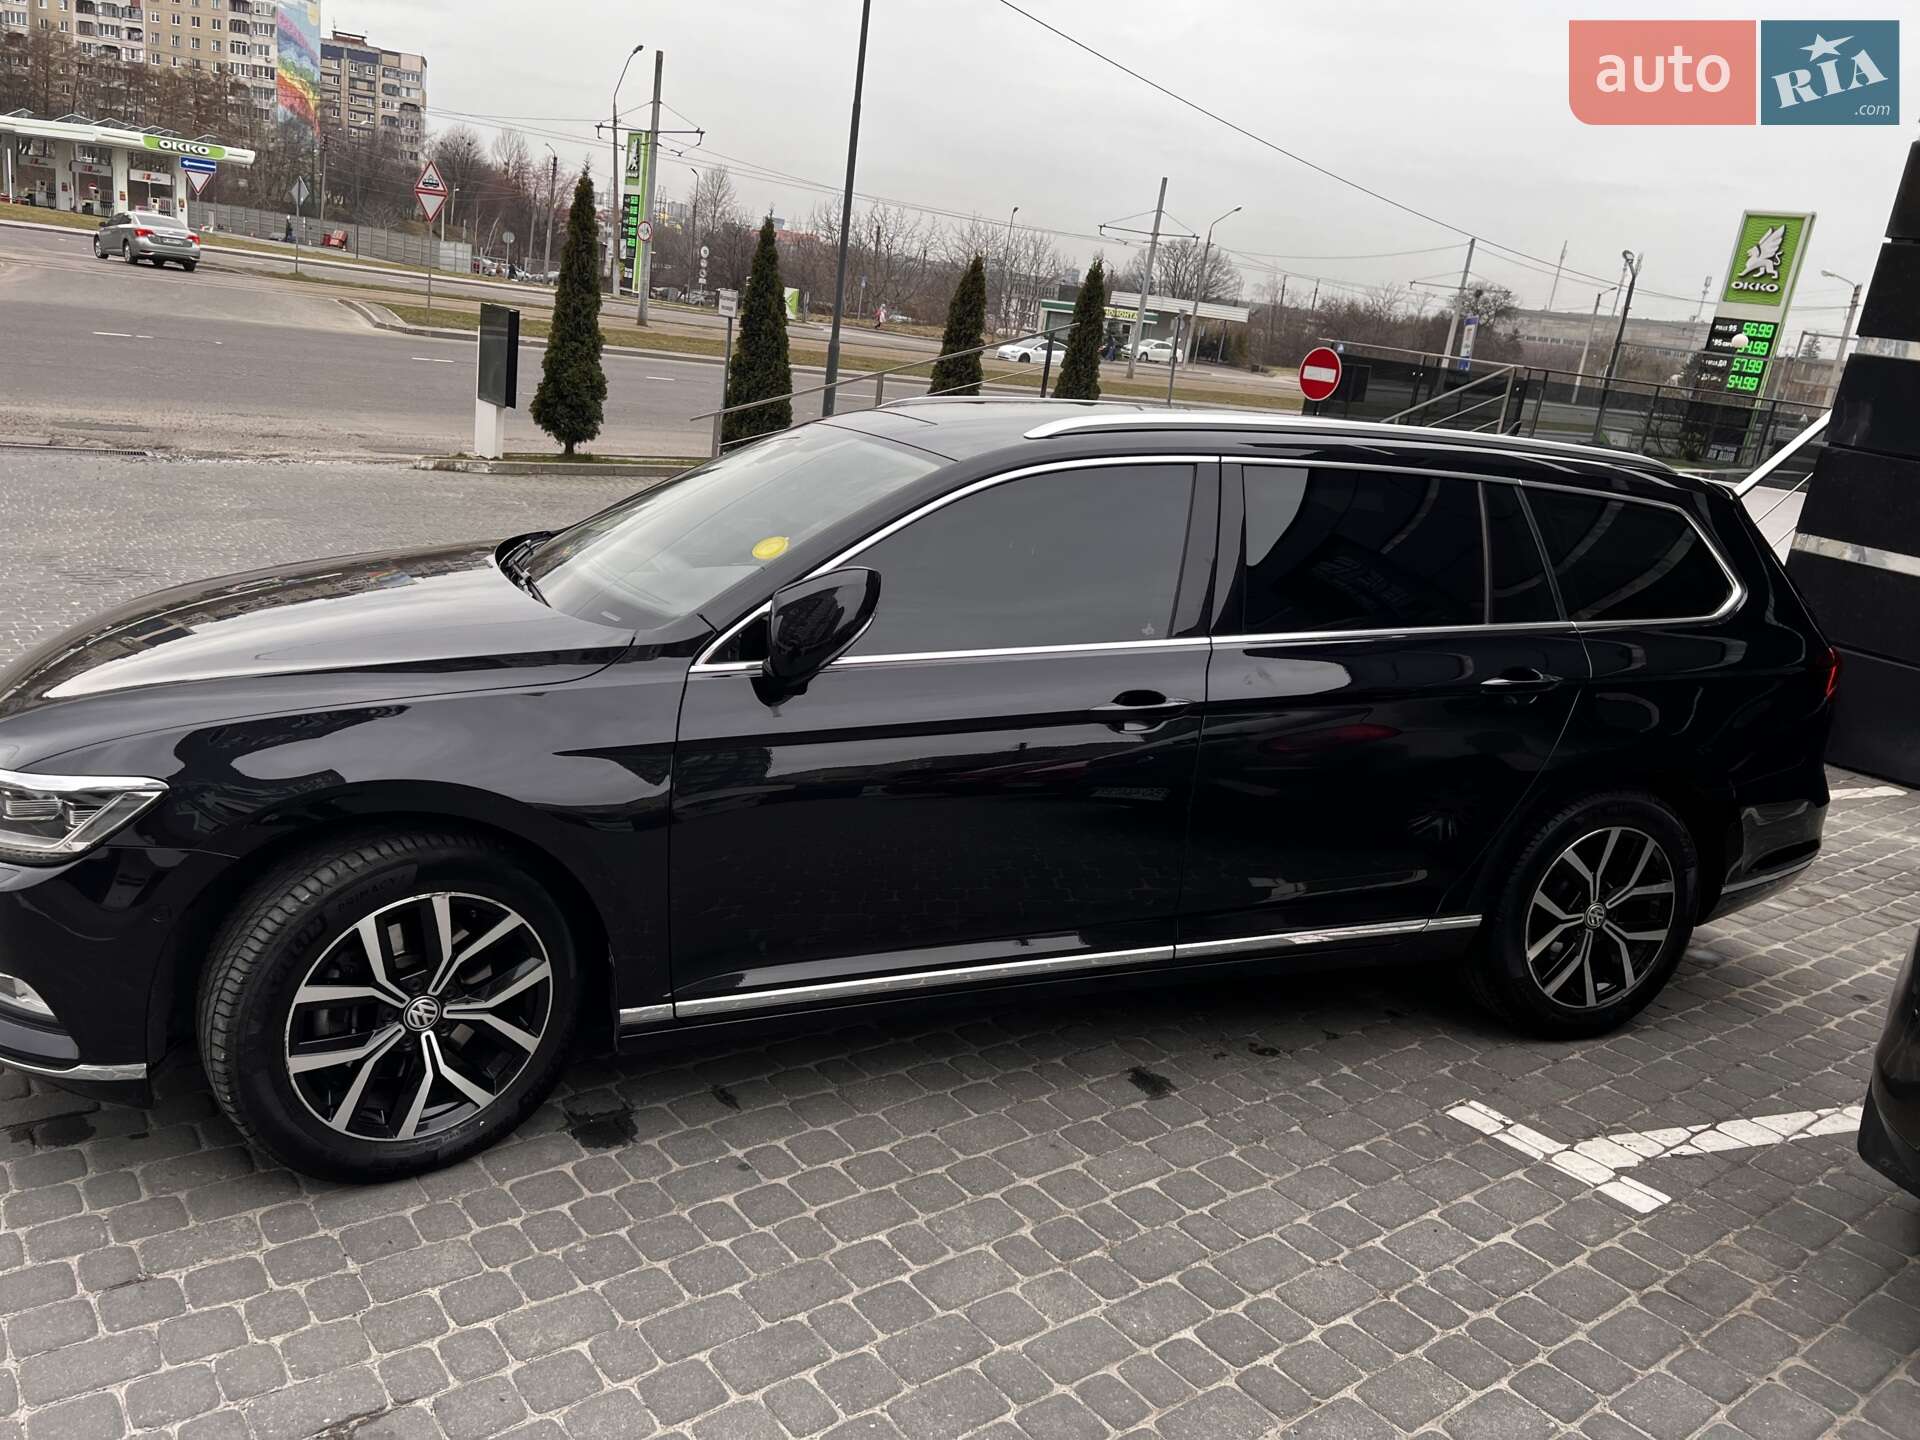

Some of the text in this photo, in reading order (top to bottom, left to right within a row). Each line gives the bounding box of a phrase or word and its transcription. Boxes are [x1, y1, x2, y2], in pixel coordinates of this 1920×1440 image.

[1743, 323, 1774, 338] 56.99
[1732, 358, 1763, 374] 57.99
[1727, 375, 1759, 391] 54.99
